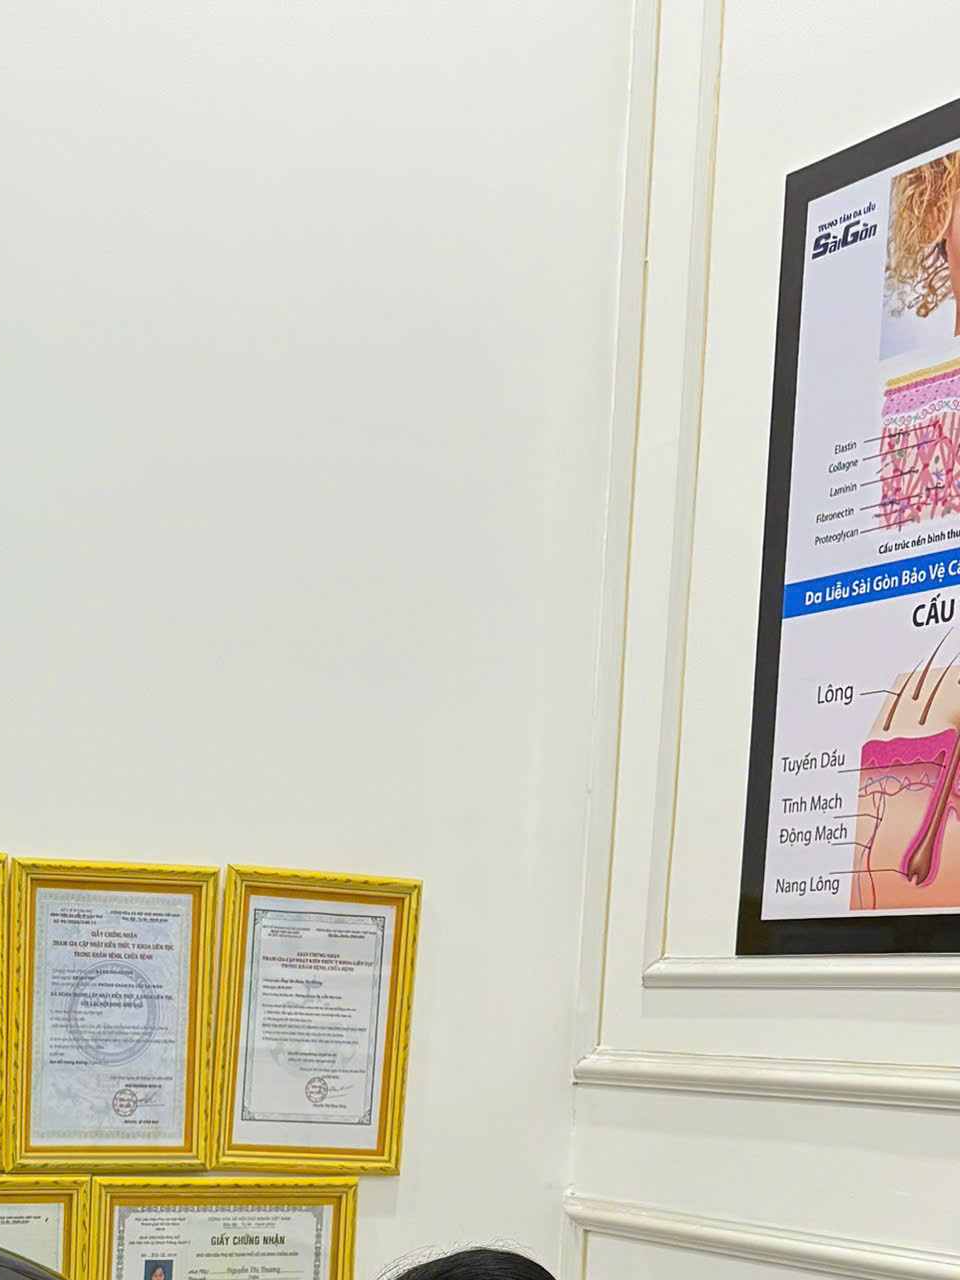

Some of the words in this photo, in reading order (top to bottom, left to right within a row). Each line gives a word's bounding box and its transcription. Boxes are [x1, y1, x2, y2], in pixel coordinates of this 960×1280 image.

[834, 441, 857, 455] Elastin
[828, 459, 858, 473] Collagne
[829, 483, 857, 497] Laminin
[816, 507, 854, 523] Fibronectin
[815, 529, 858, 546] Proteoglycan
[927, 531, 945, 544] bình
[805, 591, 822, 606] Da
[826, 582, 850, 601] Liễu
[852, 578, 870, 596] Sài
[873, 574, 898, 590] Gòn
[902, 567, 926, 585] Bảo
[929, 563, 945, 582] Vệ
[912, 593, 955, 627] CẤU
[817, 684, 854, 705] Lông
[782, 752, 817, 775] Tuyến
[809, 793, 843, 813] Mạch
[779, 828, 812, 847] Động
[815, 824, 848, 843] Mạch
[775, 878, 807, 896] Nang
[809, 876, 840, 894] Lông
[211, 1233, 230, 1246] GIẤY
[233, 1233, 260, 1246] CHỨNG
[263, 1234, 285, 1247] NHẬN
